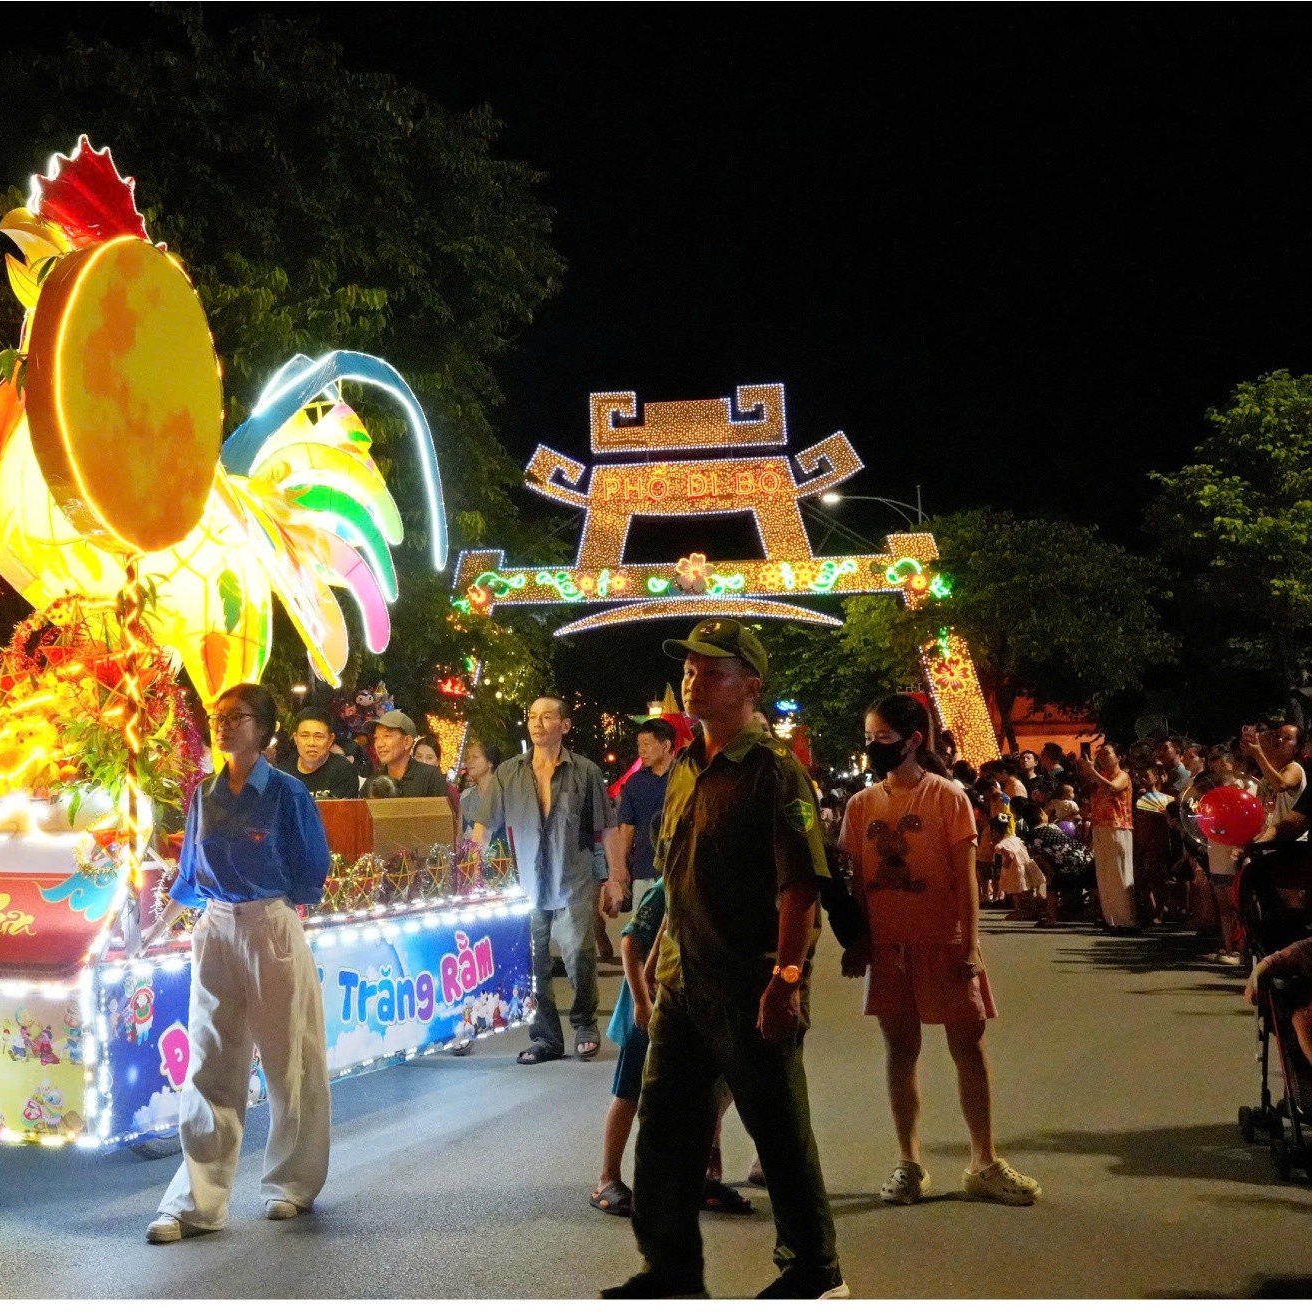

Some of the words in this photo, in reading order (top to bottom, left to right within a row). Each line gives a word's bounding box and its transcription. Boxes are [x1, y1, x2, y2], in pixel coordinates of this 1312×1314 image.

[735, 462, 781, 501] BỘ
[338, 965, 435, 1025] Trăng
[440, 930, 495, 1006] Rằm
